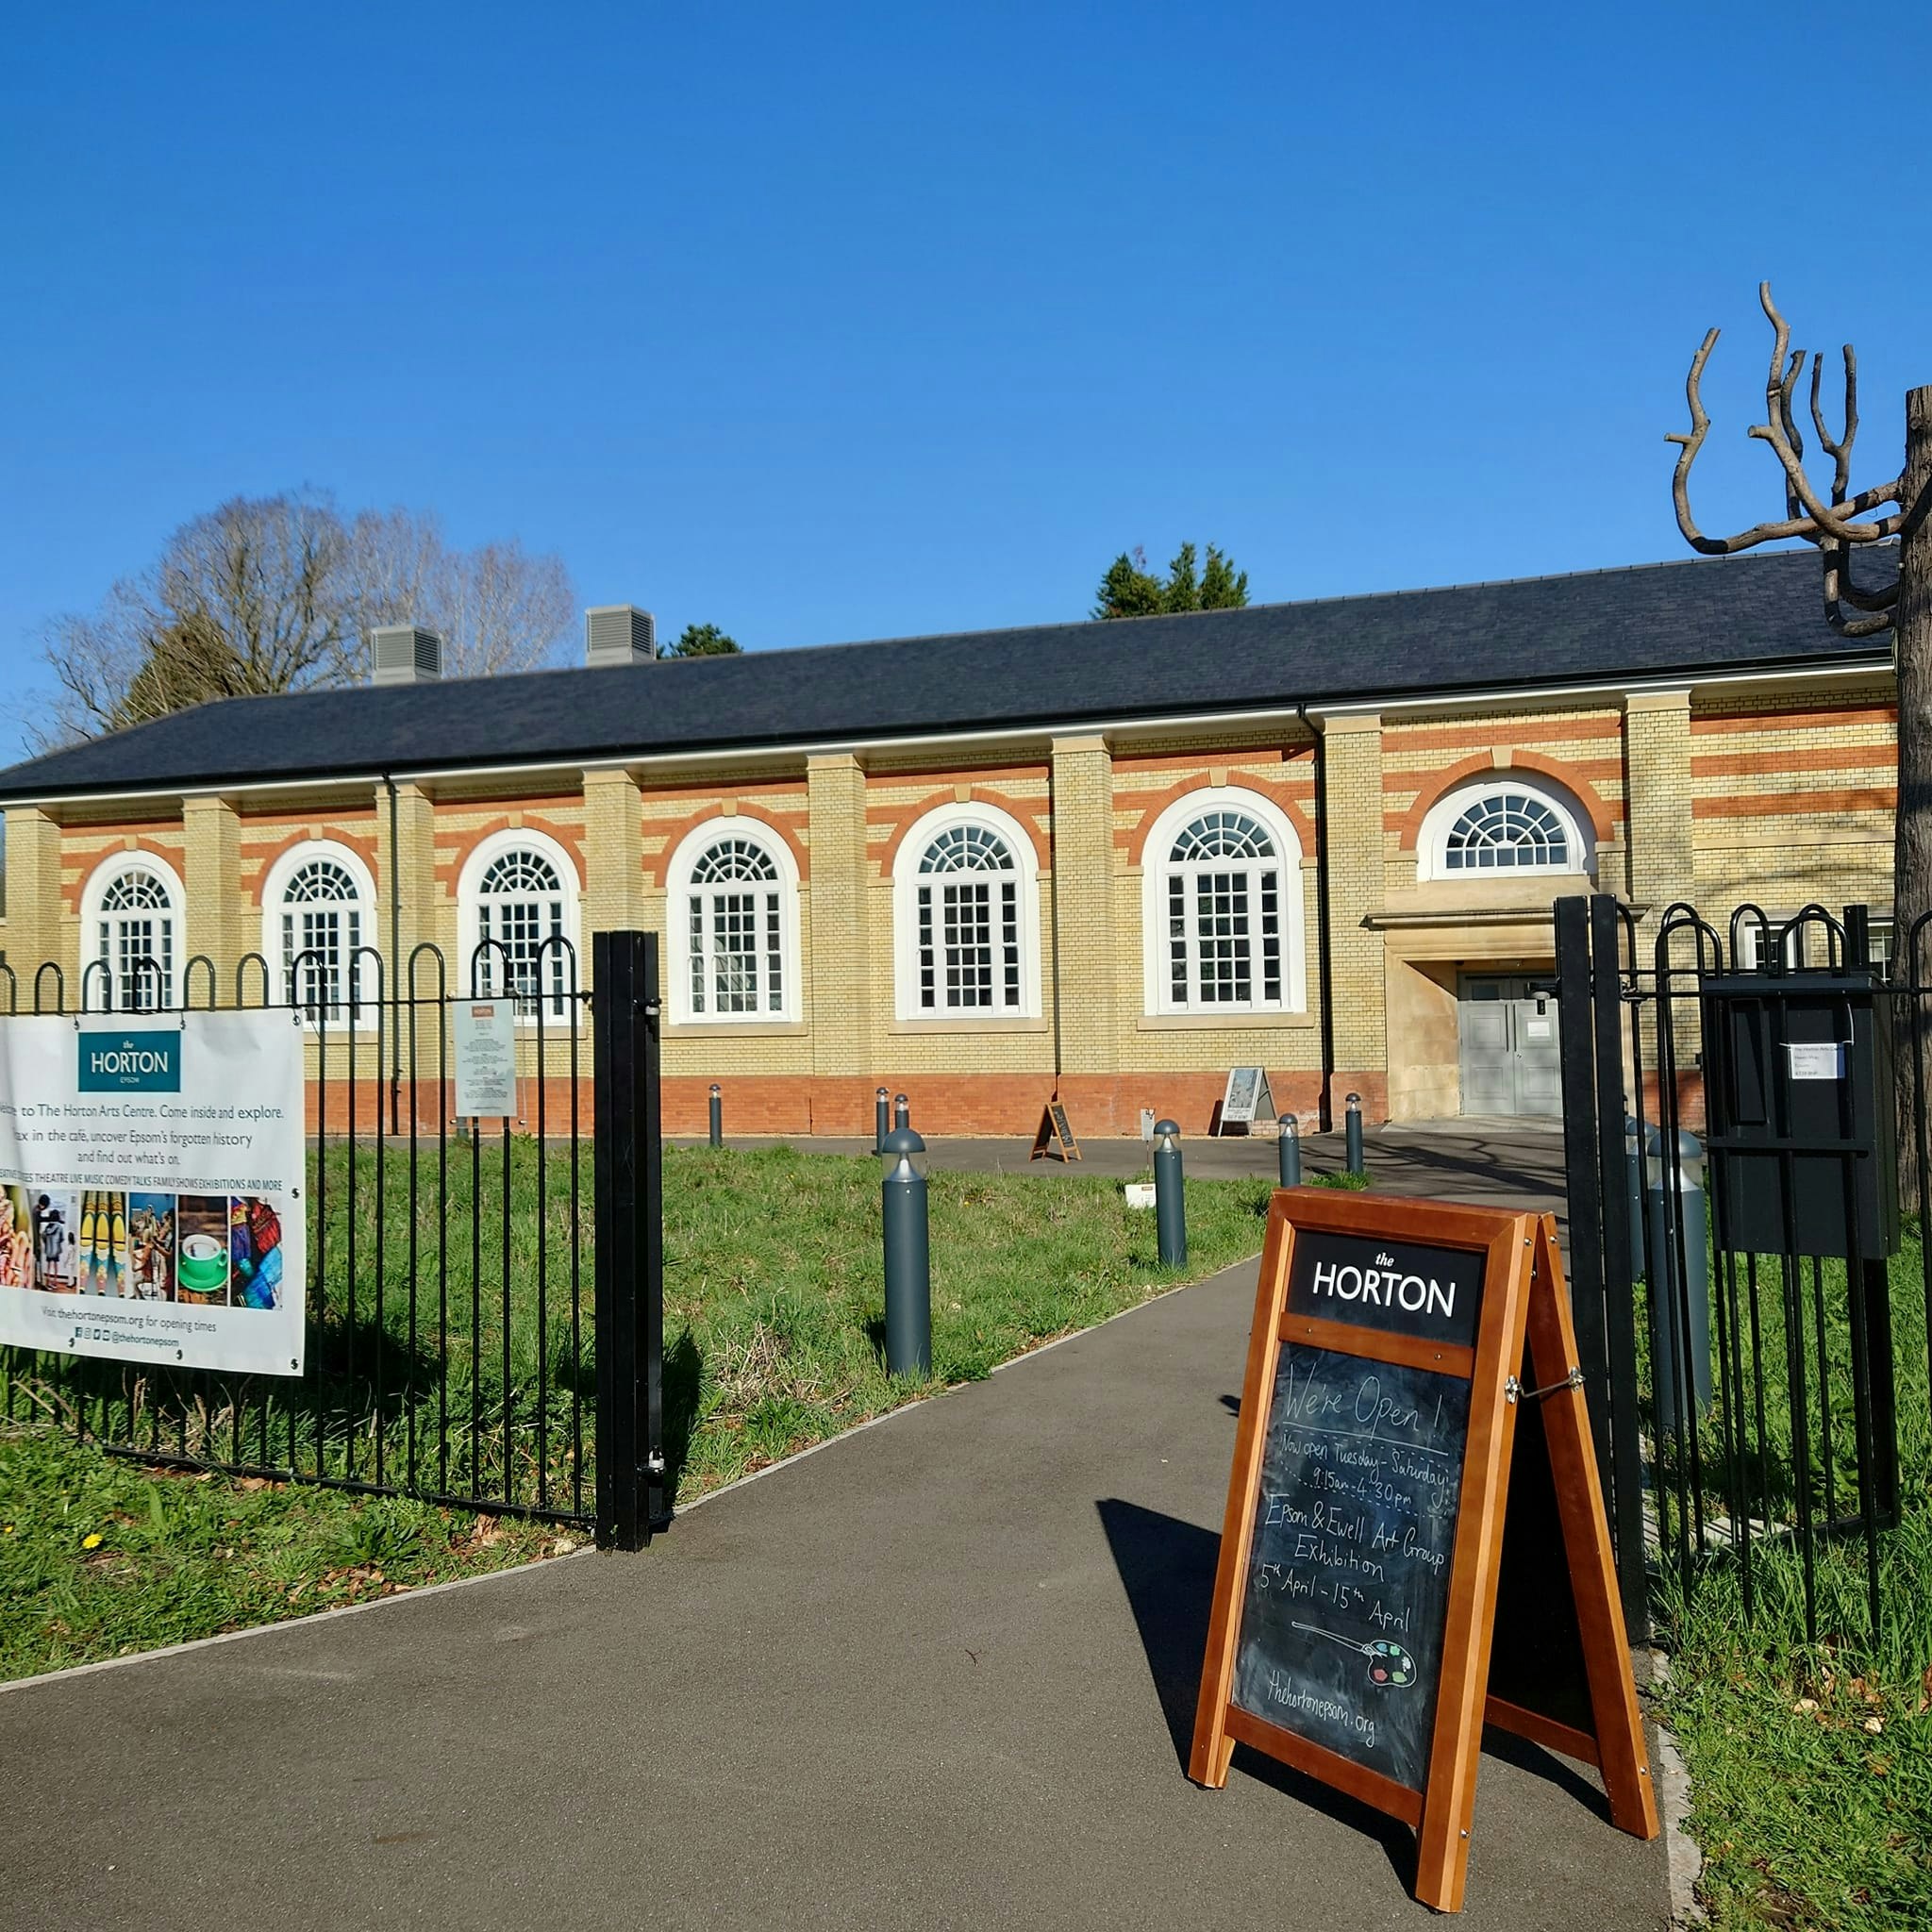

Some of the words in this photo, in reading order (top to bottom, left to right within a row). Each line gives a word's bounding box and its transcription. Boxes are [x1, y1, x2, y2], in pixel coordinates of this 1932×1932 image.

[123, 1040, 134, 1049] the
[91, 1051, 168, 1074] HORTON
[21, 1107, 35, 1117] to
[37, 1103, 61, 1117] The
[63, 1104, 98, 1117] Horton
[99, 1105, 121, 1117] Arts
[123, 1104, 158, 1118] Centre.
[160, 1104, 188, 1118] Come
[190, 1106, 216, 1119] inside
[218, 1106, 234, 1119] and
[238, 1105, 284, 1122] explore.
[32, 1128, 43, 1141] in
[48, 1128, 66, 1141] the
[91, 1133, 127, 1142] uncover
[129, 1129, 168, 1146] Epsom's
[170, 1131, 211, 1148] forgotten
[212, 1132, 253, 1149] history
[77, 1150, 94, 1163] and
[96, 1150, 114, 1163] find
[117, 1154, 133, 1164] out
[135, 1151, 165, 1165] what's
[35, 1173, 69, 1184] THEATRE
[84, 1174, 104, 1185] MUSIC
[105, 1174, 132, 1186] COMEDY
[132, 1175, 152, 1187] TALKS
[199, 1178, 245, 1191] EXHIBITIONS
[247, 1179, 262, 1191] AND
[262, 1179, 283, 1191] MORE
[1374, 1252, 1394, 1267] the
[1312, 1261, 1457, 1318] HORTON
[58, 1307, 143, 1328] thehortonepsom.org
[145, 1315, 158, 1327] for
[159, 1319, 192, 1333] opening
[194, 1322, 217, 1333] times
[1286, 1361, 1342, 1419] We're
[1355, 1375, 1420, 1441] Open
[1282, 1434, 1303, 1455] Now
[1303, 1443, 1328, 1461] open
[1335, 1442, 1380, 1485] Tuesday
[1391, 1450, 1446, 1509] Saturday
[1265, 1493, 1308, 1528] Epsom
[1312, 1500, 1325, 1529] &
[1326, 1507, 1366, 1544] Ewell
[1372, 1522, 1400, 1552] Art
[1403, 1526, 1445, 1574] Group
[1294, 1533, 1386, 1582] Exhibition
[1281, 1570, 1317, 1596] April
[1368, 1600, 1411, 1634] April
